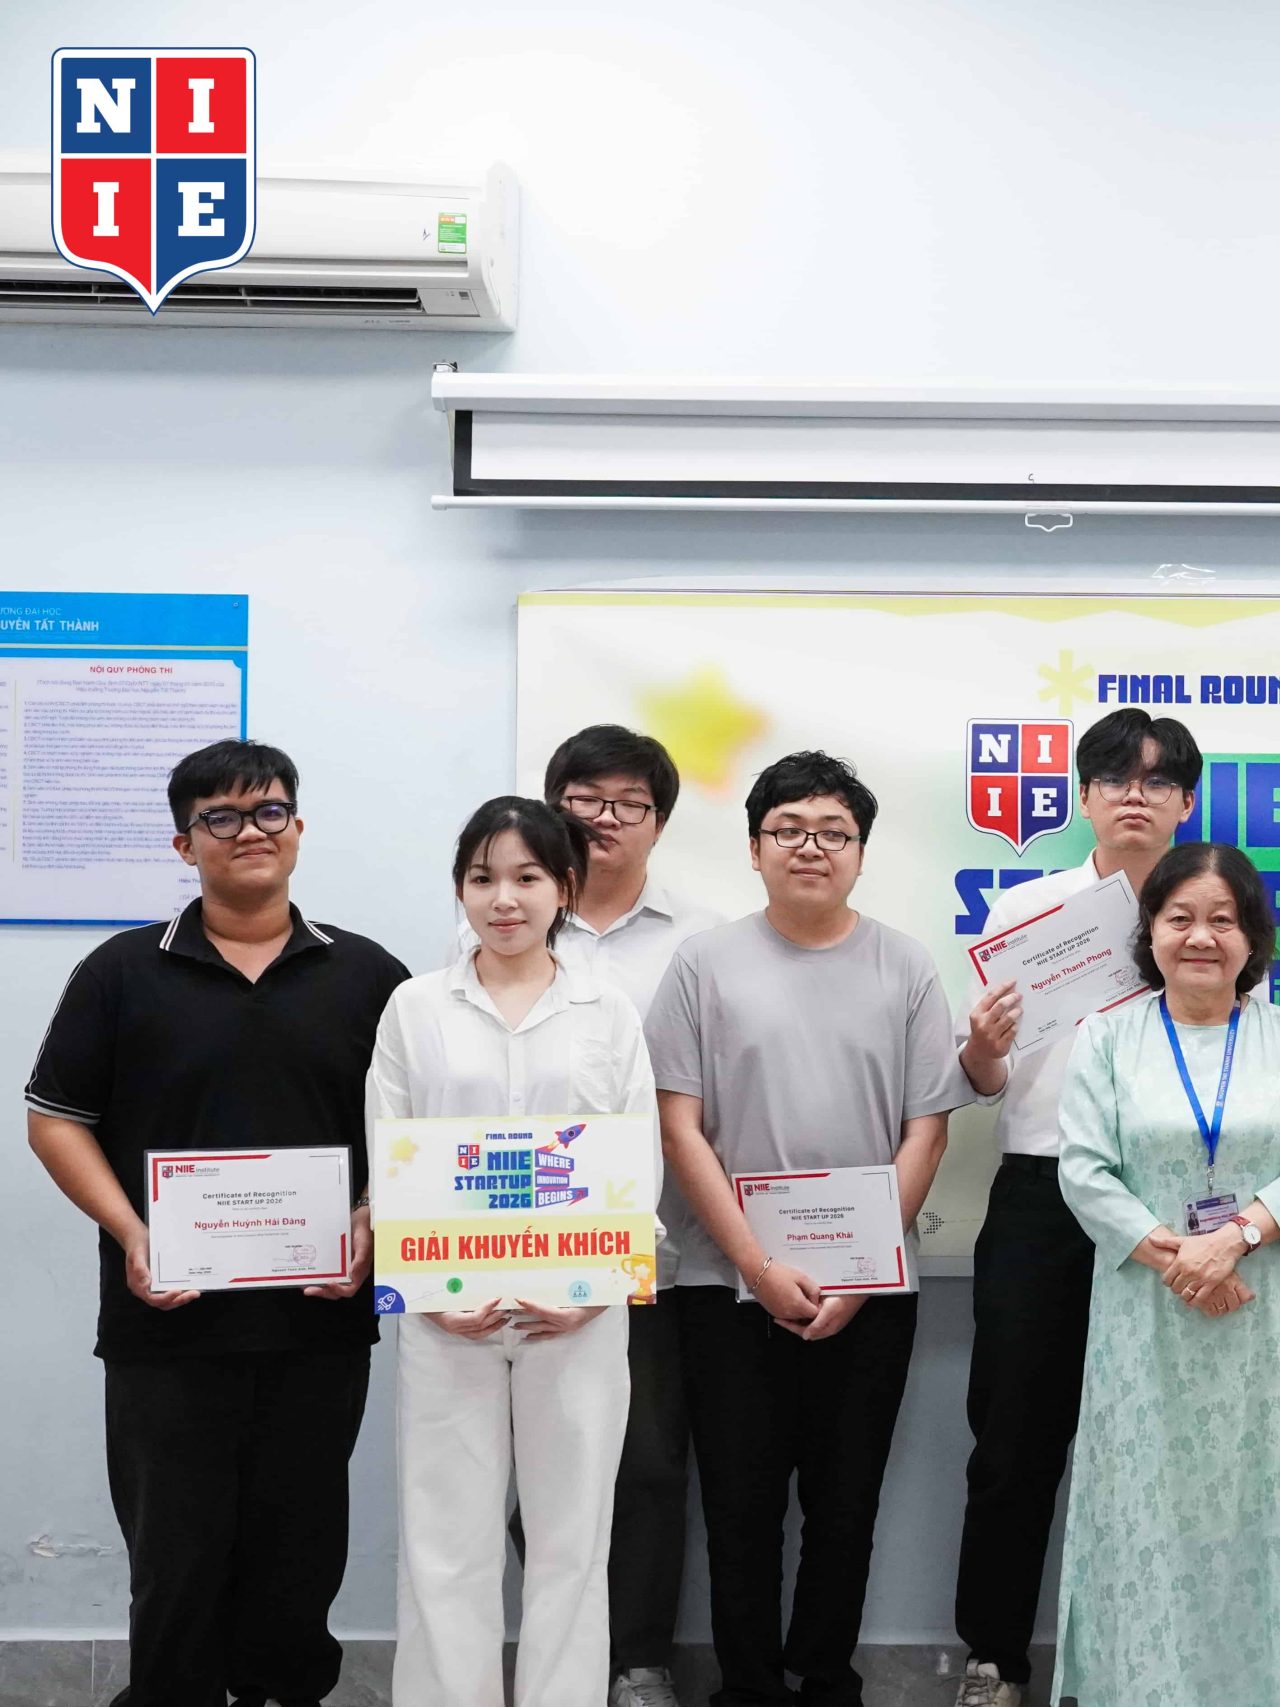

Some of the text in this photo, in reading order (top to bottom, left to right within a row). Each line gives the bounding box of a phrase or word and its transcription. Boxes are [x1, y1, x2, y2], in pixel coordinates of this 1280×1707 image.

[0, 617, 99, 631] UYỄN TẤT THÀNH
[106, 666, 124, 675] QUY
[160, 667, 173, 675] THI
[1098, 674, 1191, 704] FINAL
[989, 940, 1008, 954] NIIE
[1022, 947, 1055, 966] Certificate
[1062, 926, 1099, 947] Recognition
[1049, 949, 1067, 961] START
[1076, 937, 1091, 947] 2026
[1031, 948, 1112, 991] Nguyễn Thanh Phong
[508, 1132, 533, 1140] ROUND
[487, 1151, 531, 1170] NIIE
[538, 1153, 571, 1169] WHERE
[175, 1164, 195, 1173] NIIE
[454, 1174, 531, 1190] STARTUP
[754, 1183, 770, 1192] NIIE
[253, 1190, 297, 1199] Recognition
[489, 1194, 531, 1209] 2026
[538, 1190, 573, 1206] BEGINS
[819, 1206, 855, 1214] Recognition
[194, 1219, 229, 1230] Nguyễn
[401, 1225, 630, 1261] GIẢI KHUYẾN KHÍCH
[787, 1233, 808, 1242] Phạm
[810, 1232, 835, 1241] Quang
